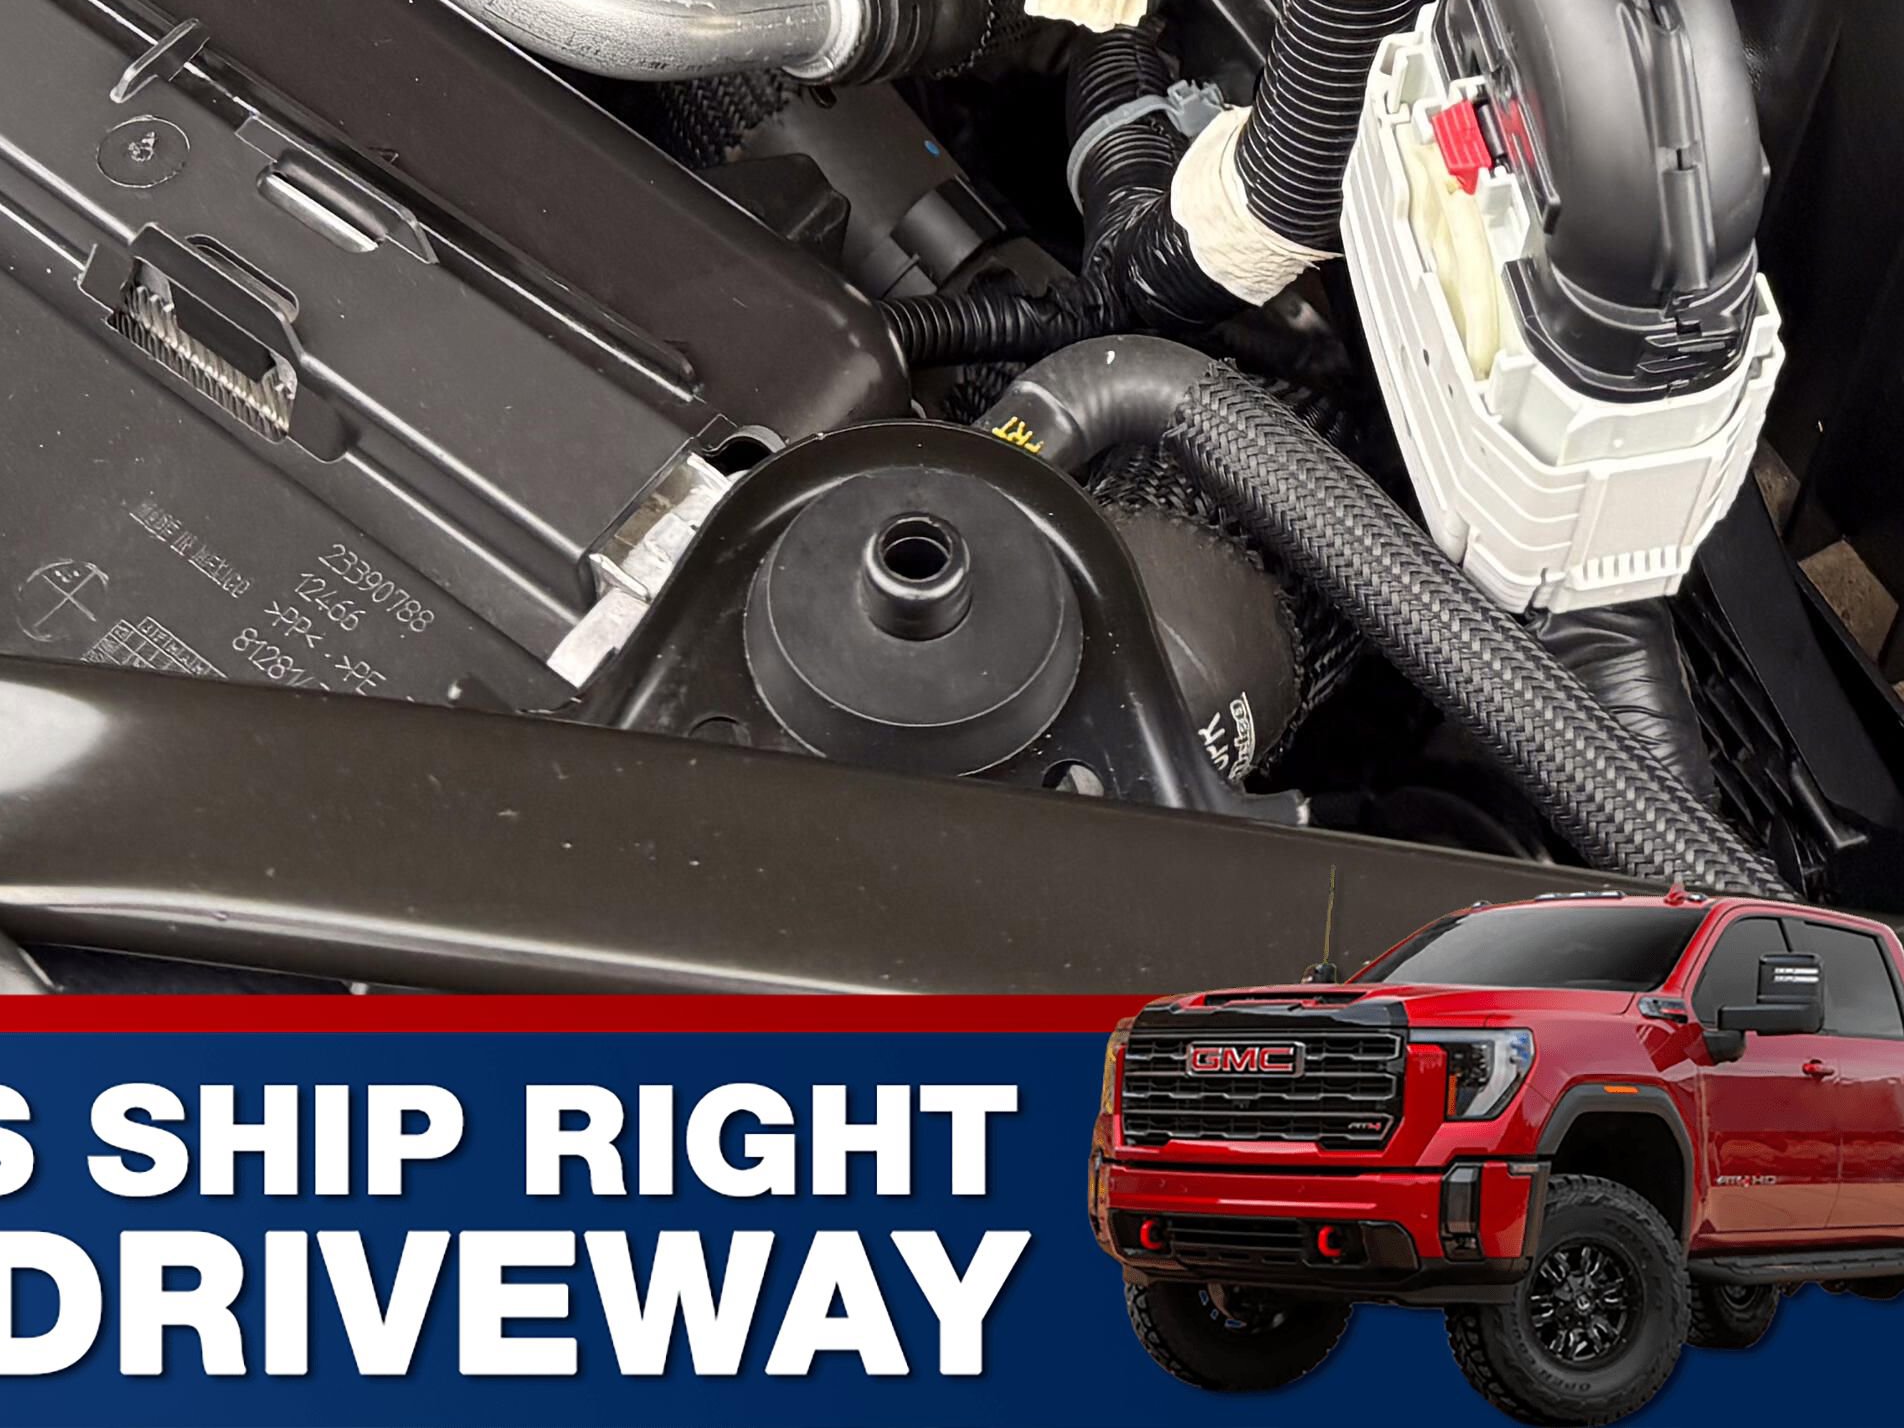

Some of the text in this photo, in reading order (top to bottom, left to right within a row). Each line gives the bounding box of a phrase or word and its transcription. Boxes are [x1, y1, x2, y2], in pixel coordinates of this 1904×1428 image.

[188, 541, 252, 599] MEXICO
[317, 543, 436, 633] 23390788
[294, 572, 367, 632] 12466
